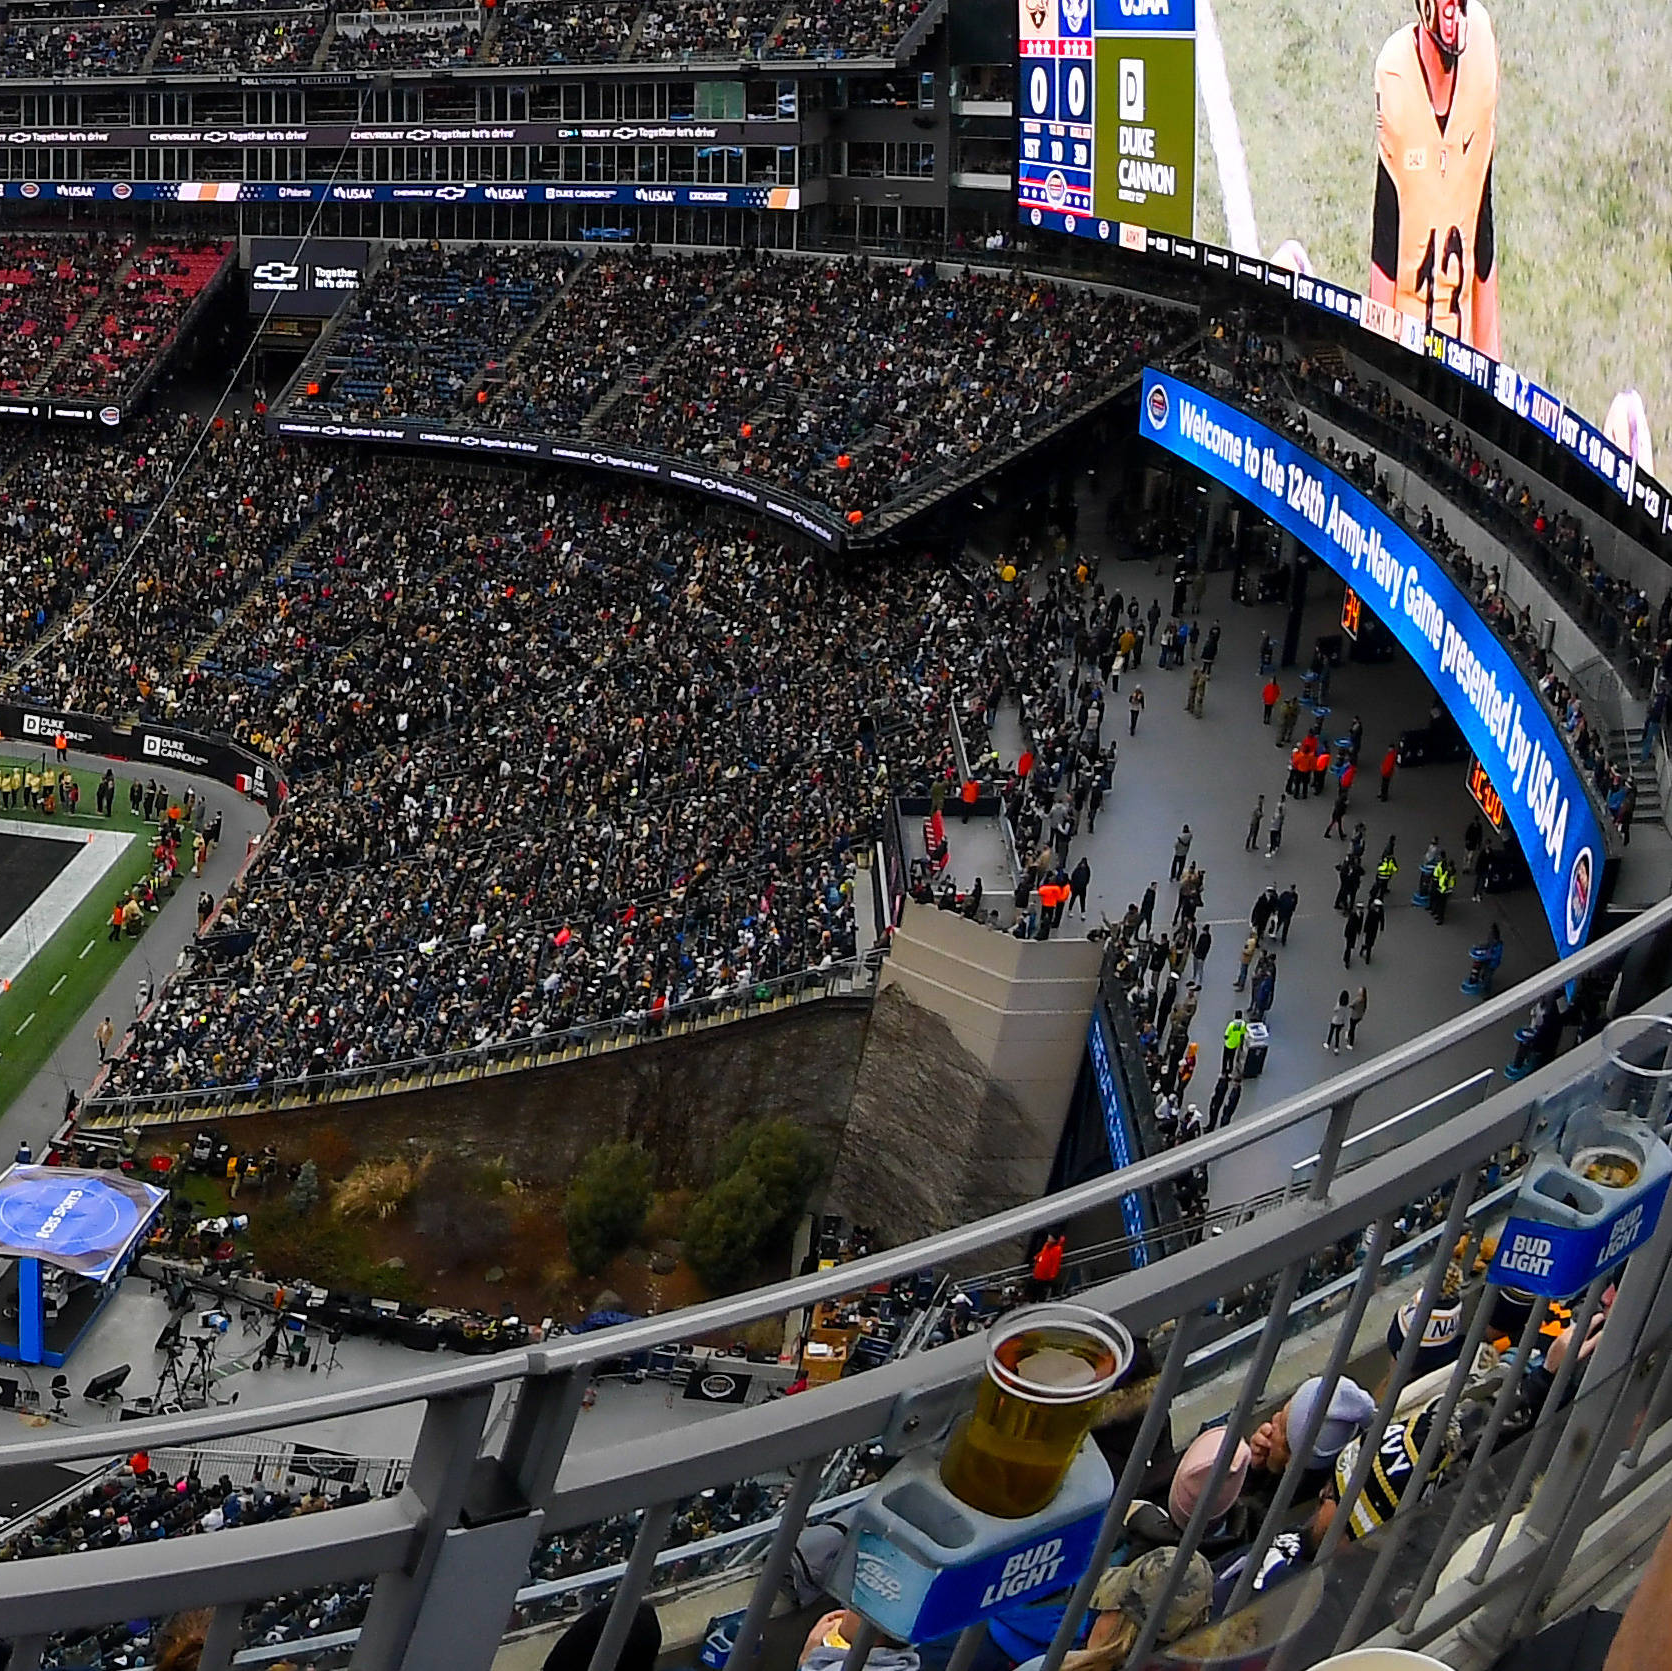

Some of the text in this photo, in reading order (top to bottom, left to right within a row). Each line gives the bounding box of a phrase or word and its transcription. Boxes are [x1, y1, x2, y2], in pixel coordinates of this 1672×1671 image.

[1030, 66, 1048, 114] 0
[1067, 67, 1085, 116] 0
[1119, 126, 1155, 159] DUKE
[1119, 159, 1176, 197] CANNON
[1179, 399, 1569, 874] Welcome to the 124th Army-Navy Game presented by USAA
[1500, 1250, 1554, 1277] LIGHT
[1513, 1234, 1552, 1257] BUD
[1002, 1538, 1063, 1579] BUD
[979, 1555, 1065, 1609] LIGHT
